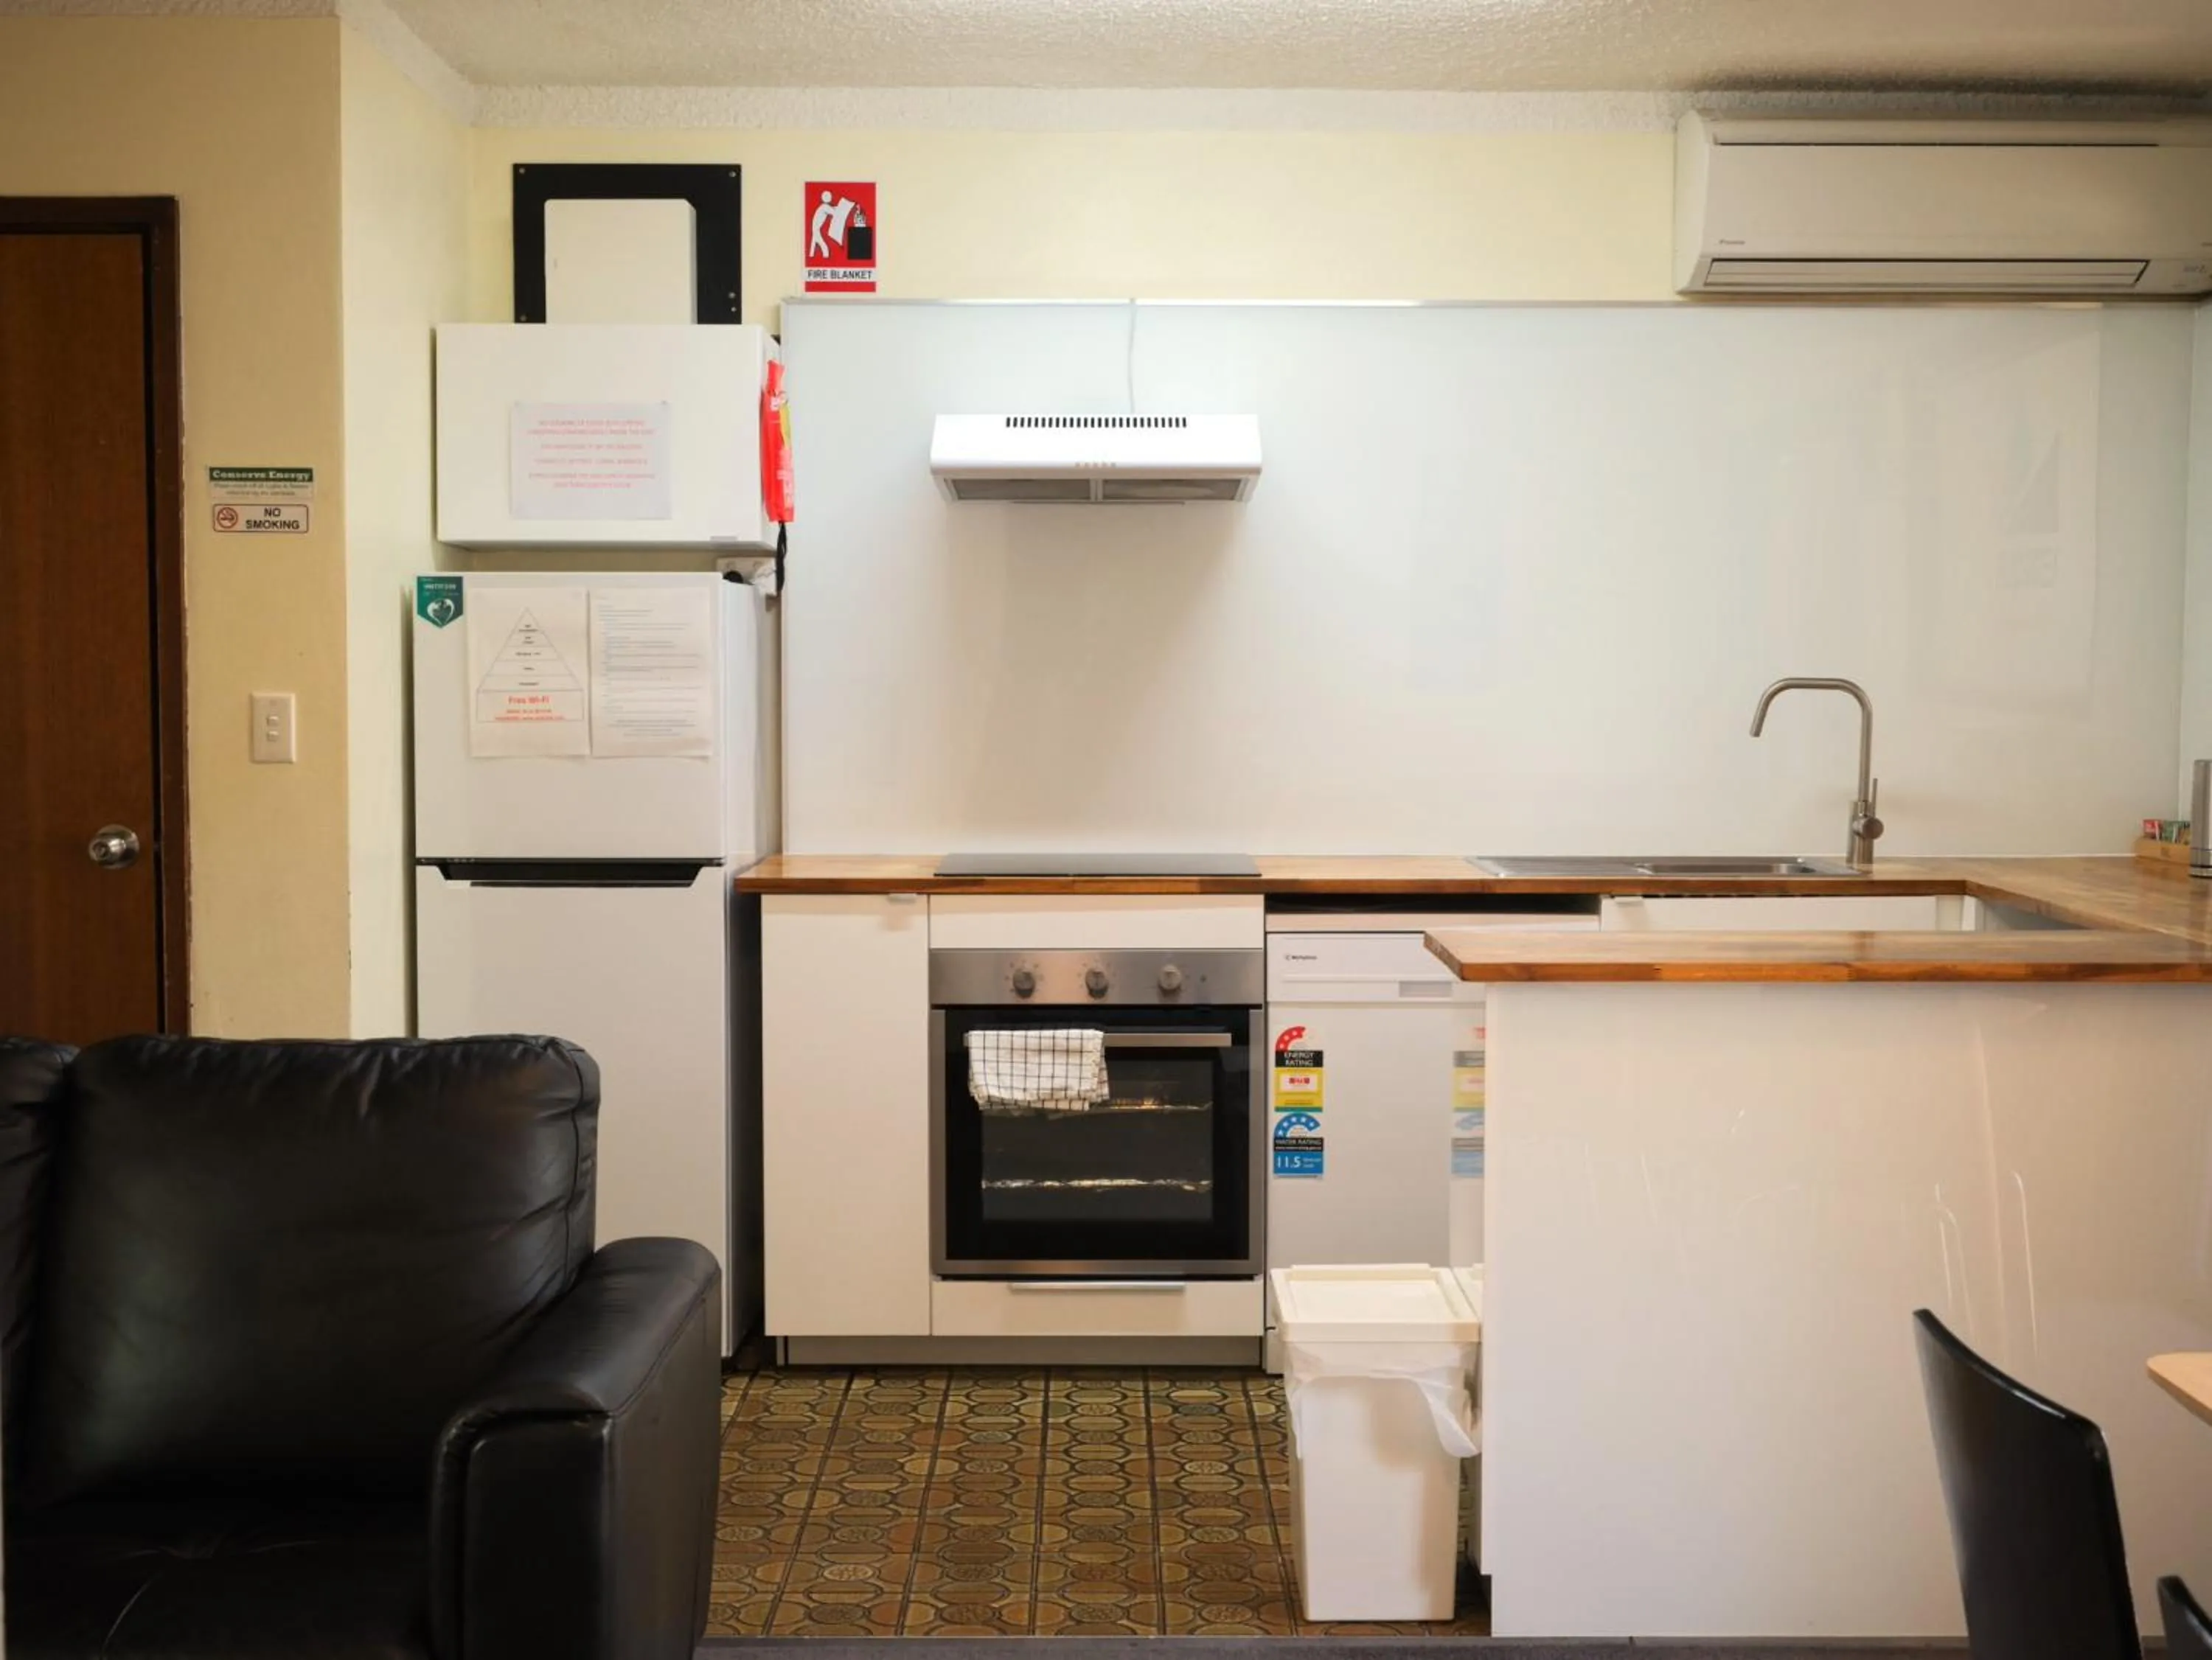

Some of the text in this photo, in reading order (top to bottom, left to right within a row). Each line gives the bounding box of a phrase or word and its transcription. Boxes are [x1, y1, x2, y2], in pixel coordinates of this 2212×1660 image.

[807, 270, 872, 279] FIRE BLANKET
[212, 470, 310, 481] Conserve Energy
[263, 507, 281, 517] NO
[246, 520, 300, 530] SMOKING
